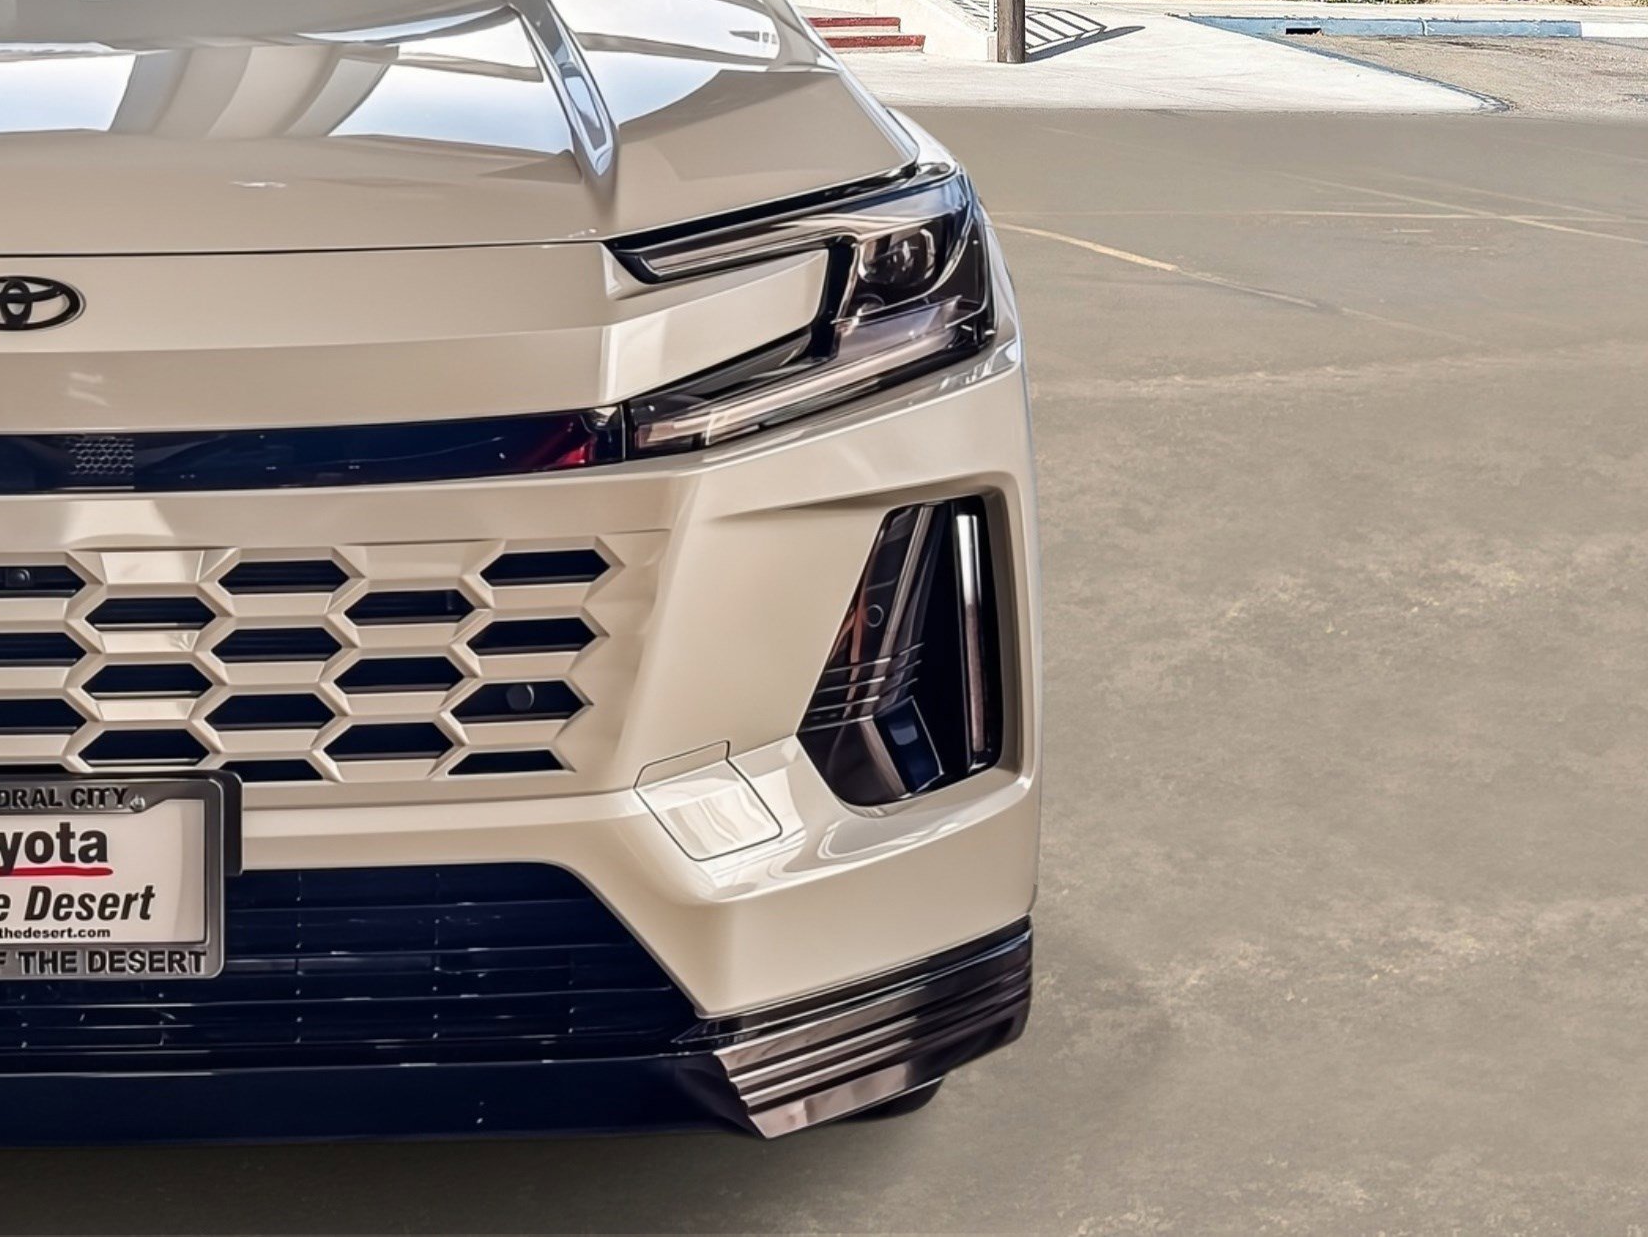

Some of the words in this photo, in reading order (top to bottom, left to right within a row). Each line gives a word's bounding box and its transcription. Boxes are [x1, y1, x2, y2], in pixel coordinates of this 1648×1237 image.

[70, 786, 128, 808] CITY
[24, 885, 155, 922] Desert
[18, 951, 78, 975] THE
[87, 950, 206, 974] DESERT
